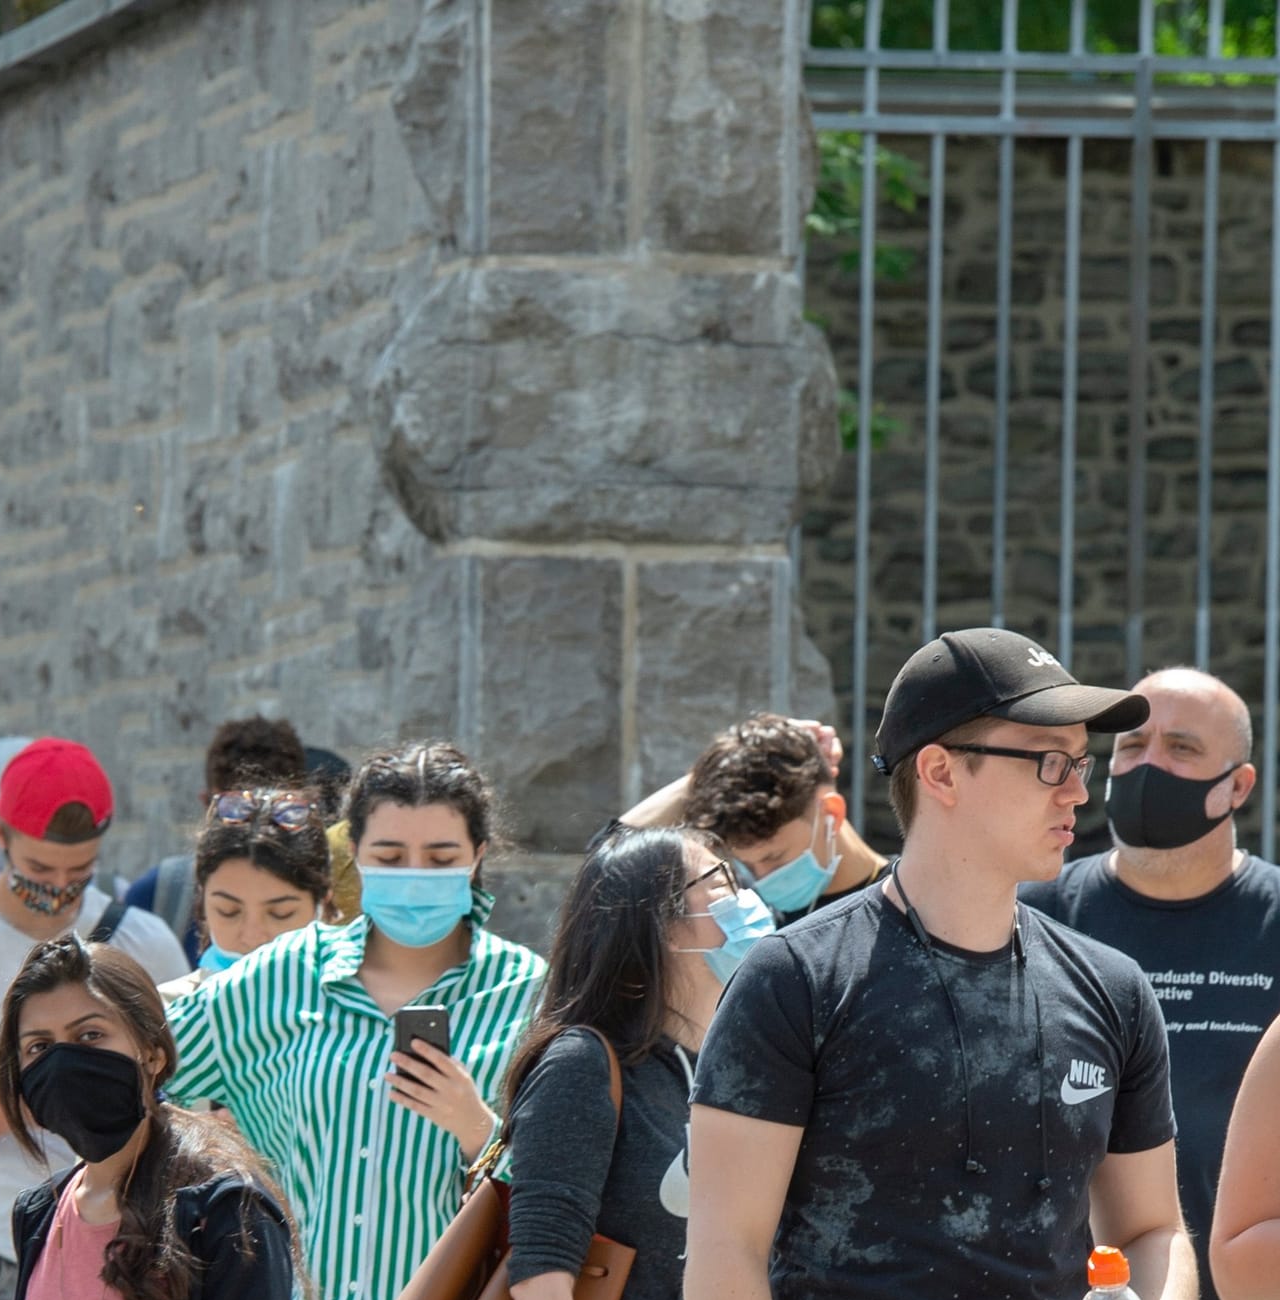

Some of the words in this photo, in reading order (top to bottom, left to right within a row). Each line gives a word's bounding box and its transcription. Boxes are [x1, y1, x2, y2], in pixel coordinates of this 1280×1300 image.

[1208, 971, 1274, 990] Diversity
[1154, 986, 1193, 1000] ative
[1185, 1021, 1208, 1032] and
[1070, 1058, 1106, 1089] NIKE
